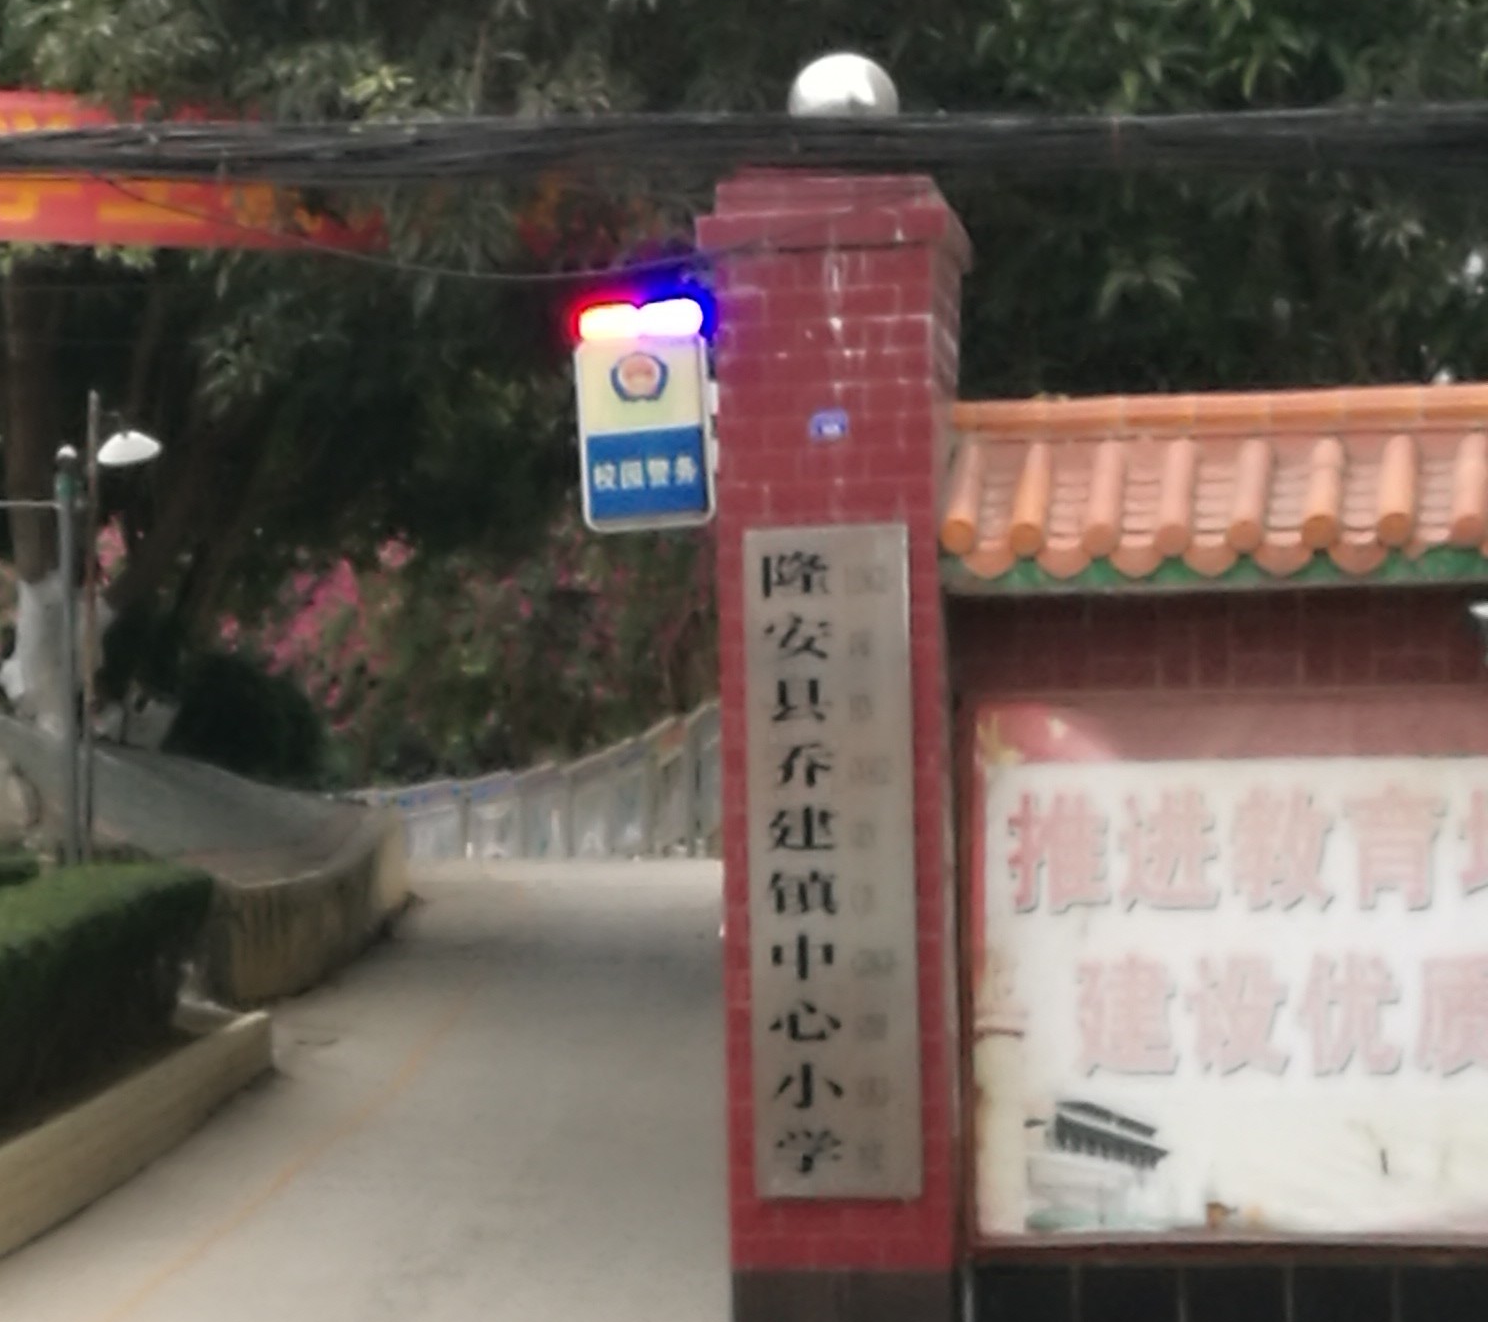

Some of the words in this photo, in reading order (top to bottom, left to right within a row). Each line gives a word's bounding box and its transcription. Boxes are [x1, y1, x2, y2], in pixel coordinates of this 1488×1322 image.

[759, 549, 845, 1177] 隆安县乔建镇中心小学
[1008, 783, 1488, 915] 推进教育
